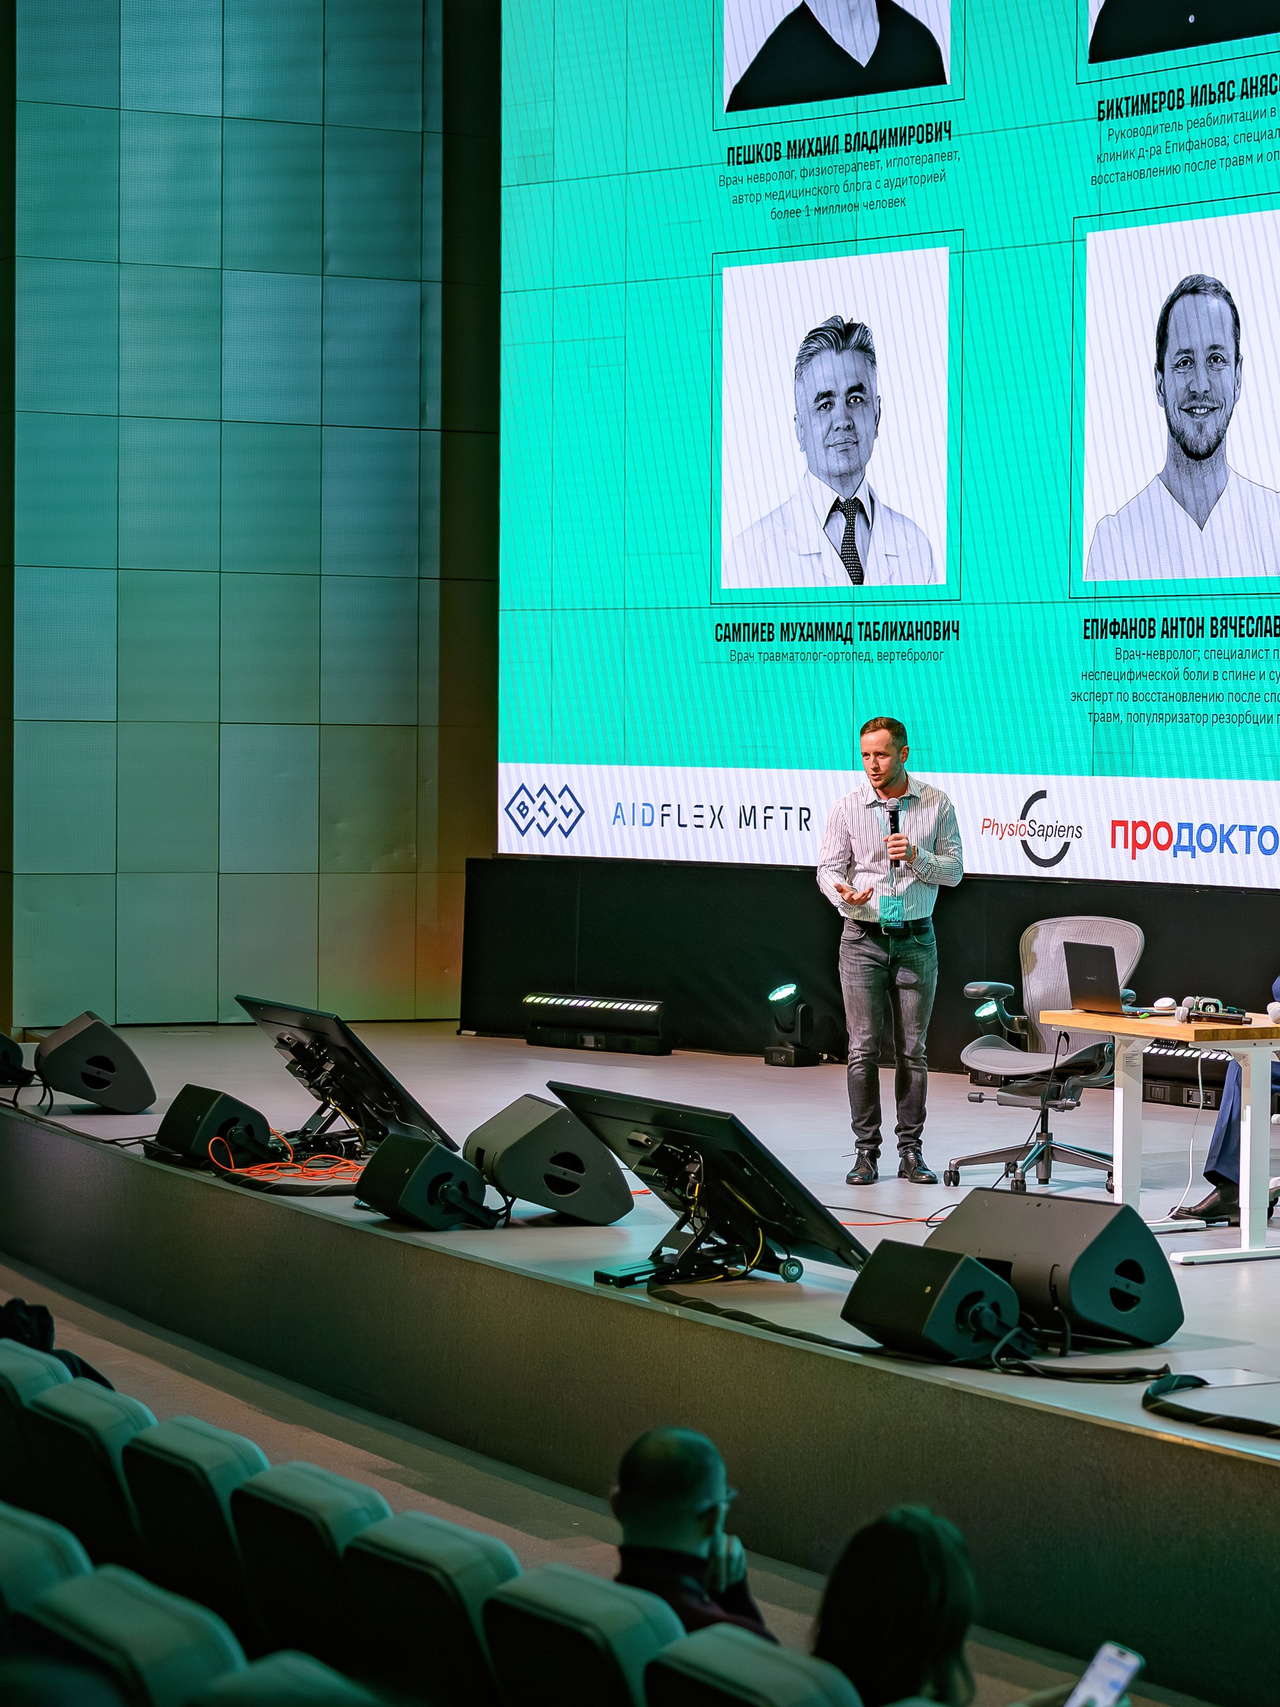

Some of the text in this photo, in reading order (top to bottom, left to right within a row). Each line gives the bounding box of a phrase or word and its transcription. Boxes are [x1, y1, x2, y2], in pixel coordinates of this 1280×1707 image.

[1097, 88, 1184, 121] БИКТИМЕРОВ
[1191, 80, 1235, 107] ИЛЬЯС
[1108, 120, 1183, 144] Руководитель
[1186, 107, 1267, 133] реабилитации
[1270, 108, 1276, 117] в
[727, 120, 952, 166] ПЕШКОВ МИХАИЛ ВЛАДИМИРОВИЧ
[1097, 148, 1135, 164] клиник
[1138, 146, 1162, 160] д-ра
[1165, 134, 1230, 155] Епифанова;
[719, 150, 961, 188] Врач невролог, физиотерапевт, иглотерапевт,
[1091, 165, 1181, 186] восстановлению
[1184, 160, 1216, 174] после
[1219, 153, 1253, 171] травм
[1256, 153, 1263, 163] и
[732, 170, 946, 205] автор медицинского блога с аудиторией
[771, 197, 906, 220] более 1 миллион человек
[715, 620, 960, 644] САМПИЕВ МУХАММАД ТАБЛИХАНОВИЧ
[1084, 618, 1156, 639] ЕПИФАНОВ
[1161, 617, 1205, 638] АНТОН
[730, 648, 943, 664] Врач травматолог-ортопед, вертебролог
[1115, 647, 1200, 663] Врач-невролог;
[1204, 648, 1270, 663] специалист
[1081, 667, 1180, 683] неспецифической
[1183, 667, 1209, 681] боли
[1213, 670, 1219, 680] в
[1222, 670, 1256, 681] спине
[1259, 670, 1265, 680] и
[1071, 691, 1113, 705] эксперт
[1117, 691, 1129, 701] по
[1132, 690, 1224, 702] восстановлению
[1227, 691, 1260, 702] после
[1088, 711, 1123, 724] травм,
[1126, 710, 1208, 726] популяризатор
[1212, 711, 1273, 727] резорбции
[613, 802, 811, 831] AIDFLEX MFTR
[981, 818, 1082, 841] PhysioSapiens
